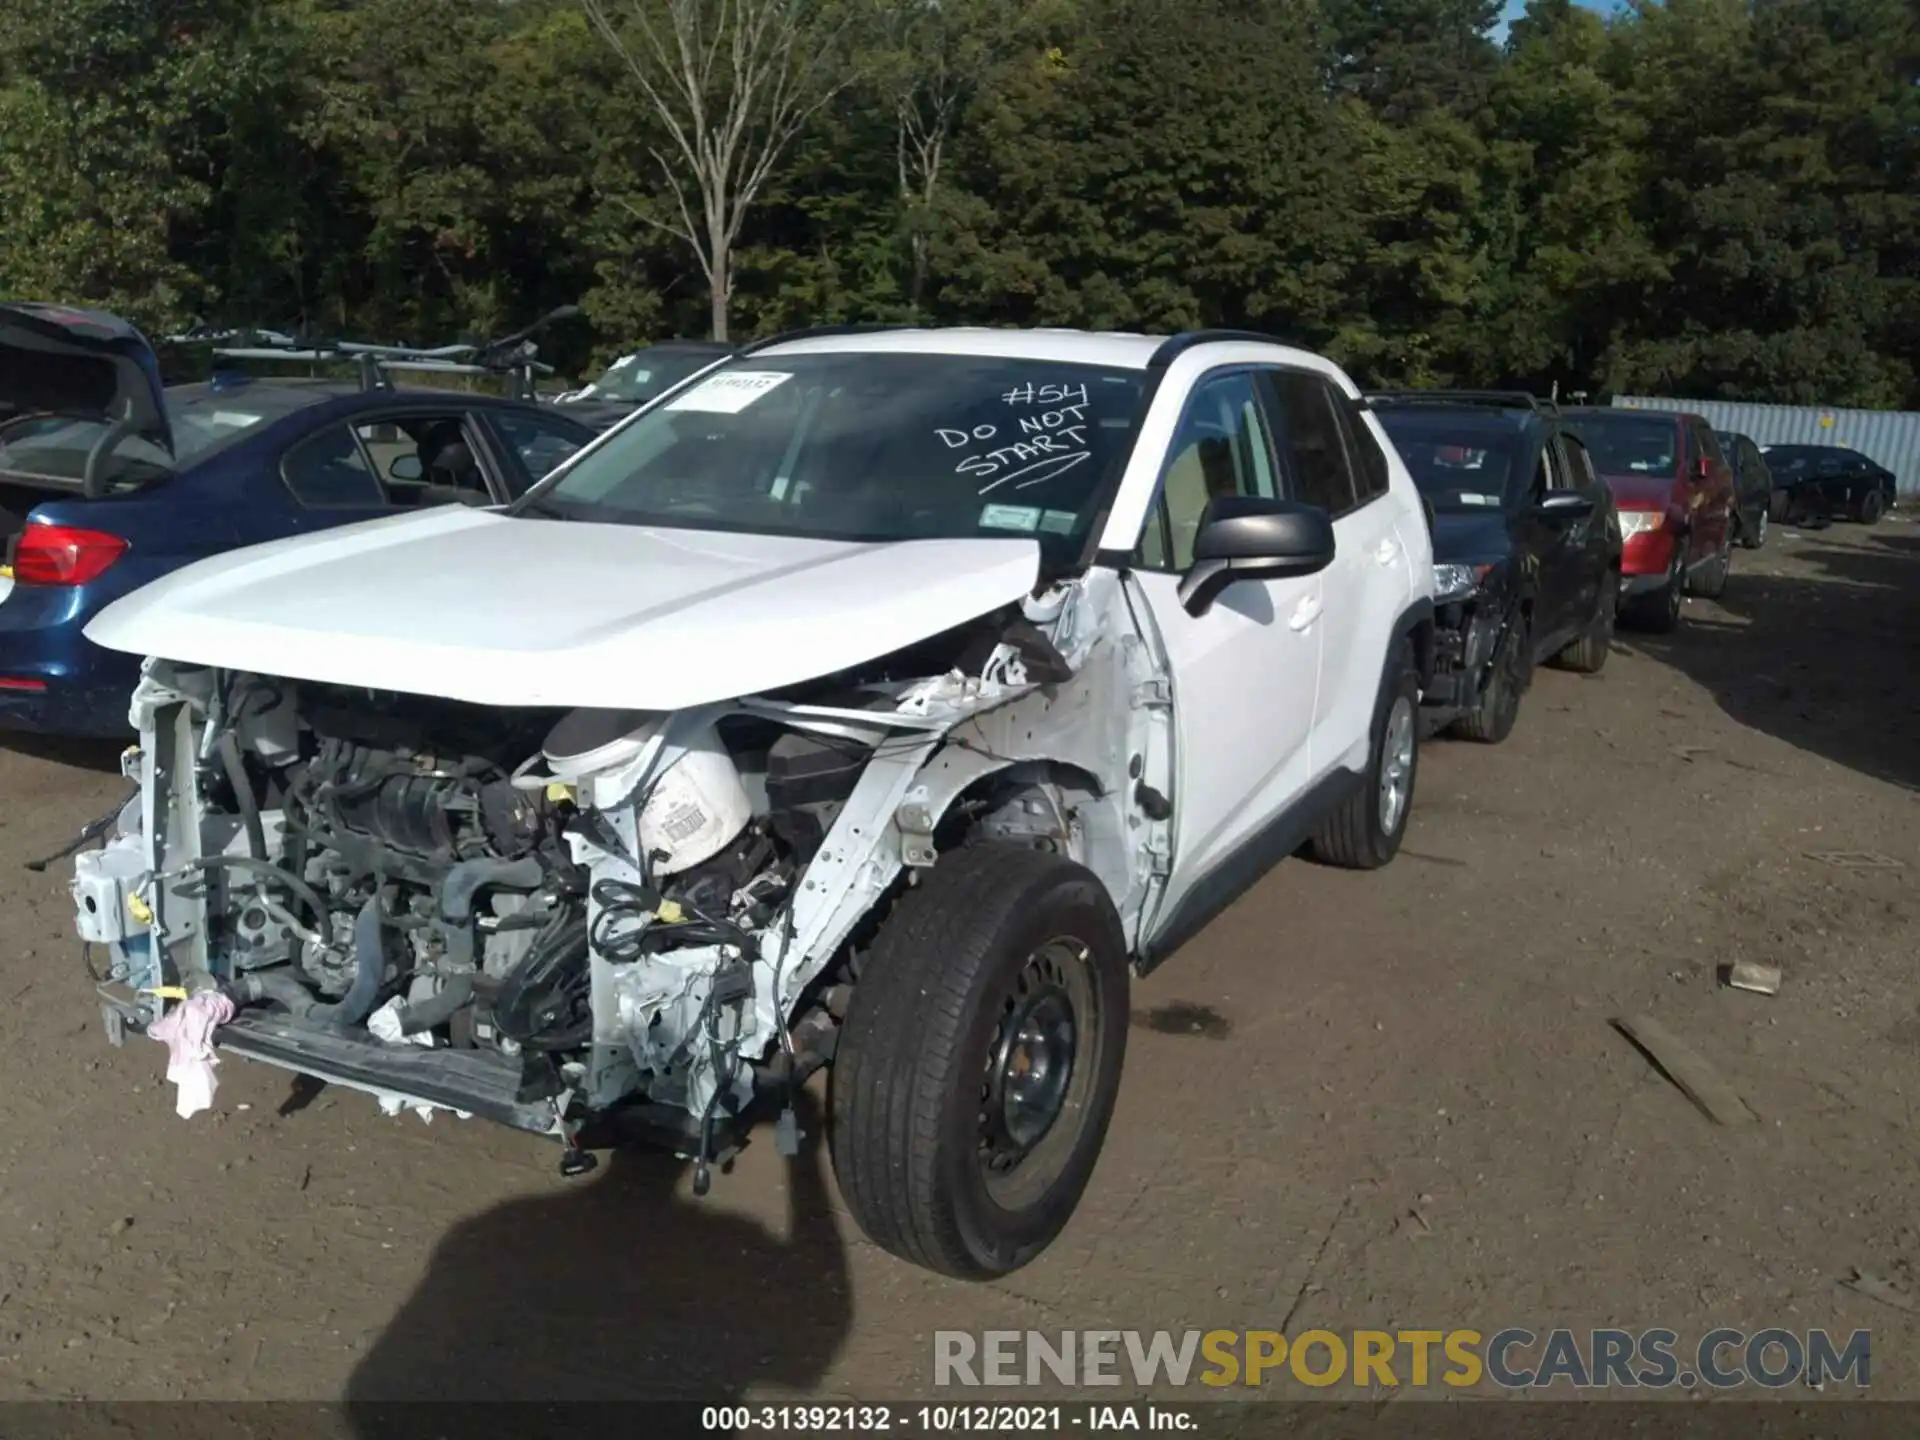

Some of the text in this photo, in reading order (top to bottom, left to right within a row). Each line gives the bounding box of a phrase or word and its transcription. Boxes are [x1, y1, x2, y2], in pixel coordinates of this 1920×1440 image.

[1002, 382, 1089, 405] #54
[934, 402, 1091, 448] DO NOT
[955, 425, 1087, 476] START
